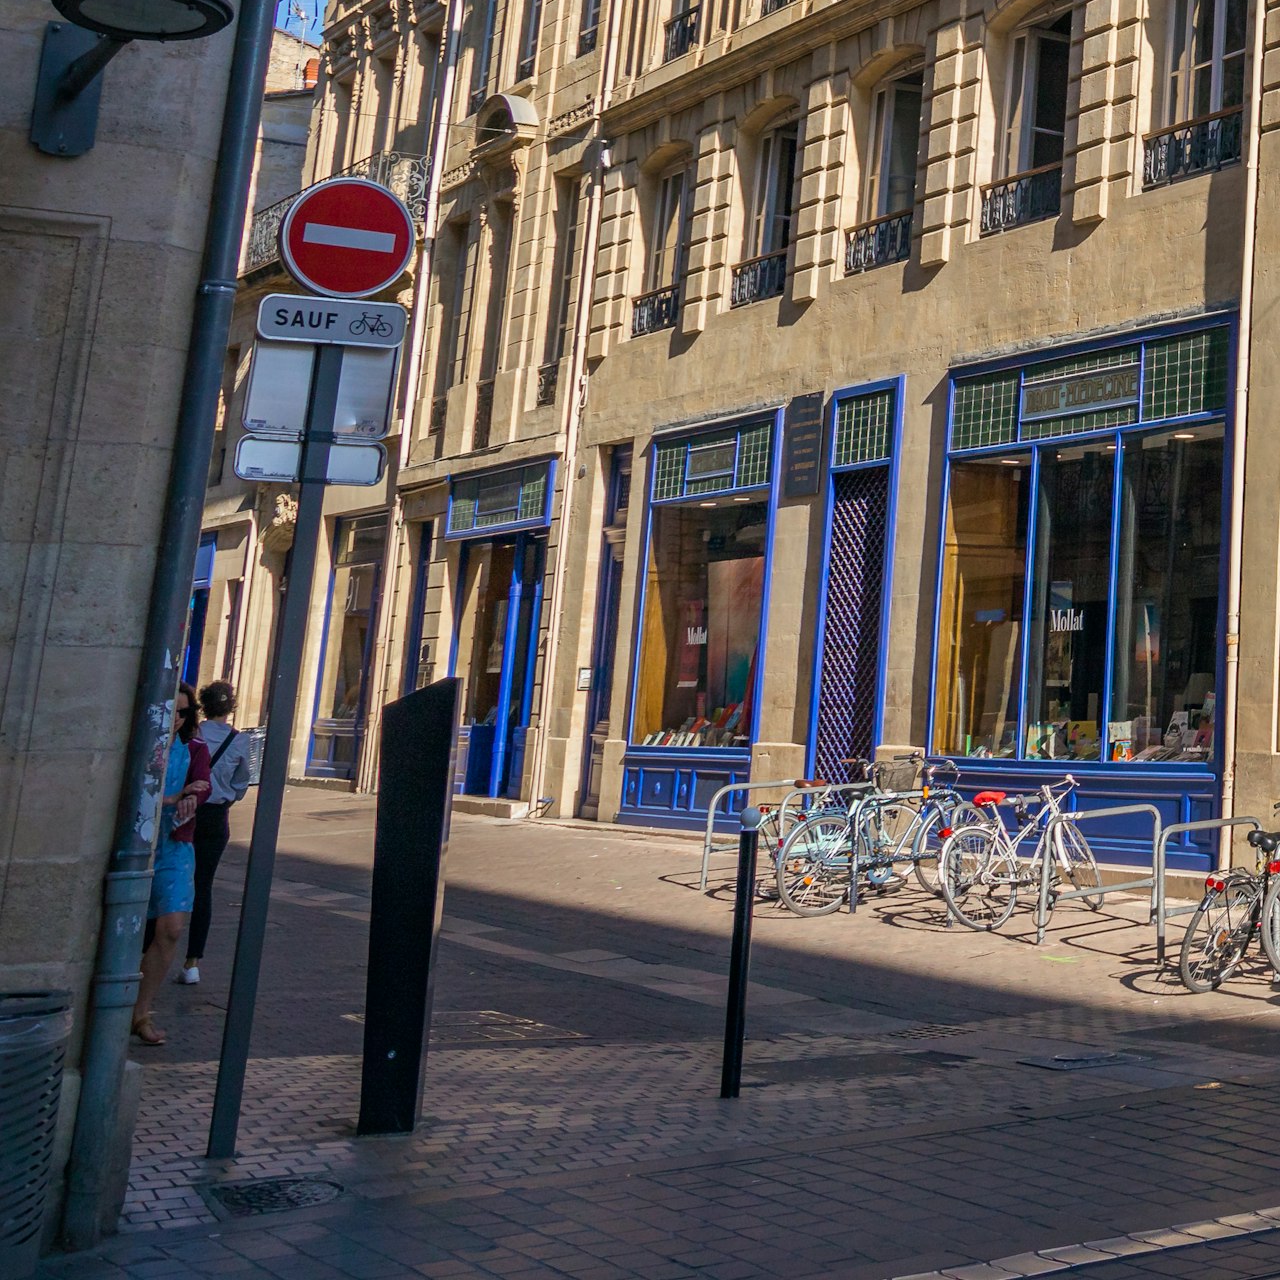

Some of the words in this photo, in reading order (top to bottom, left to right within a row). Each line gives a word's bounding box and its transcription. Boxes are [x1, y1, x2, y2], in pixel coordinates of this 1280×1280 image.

[274, 308, 338, 329] SAUF
[1050, 608, 1084, 632] Mollat
[687, 626, 707, 645] Mollat
